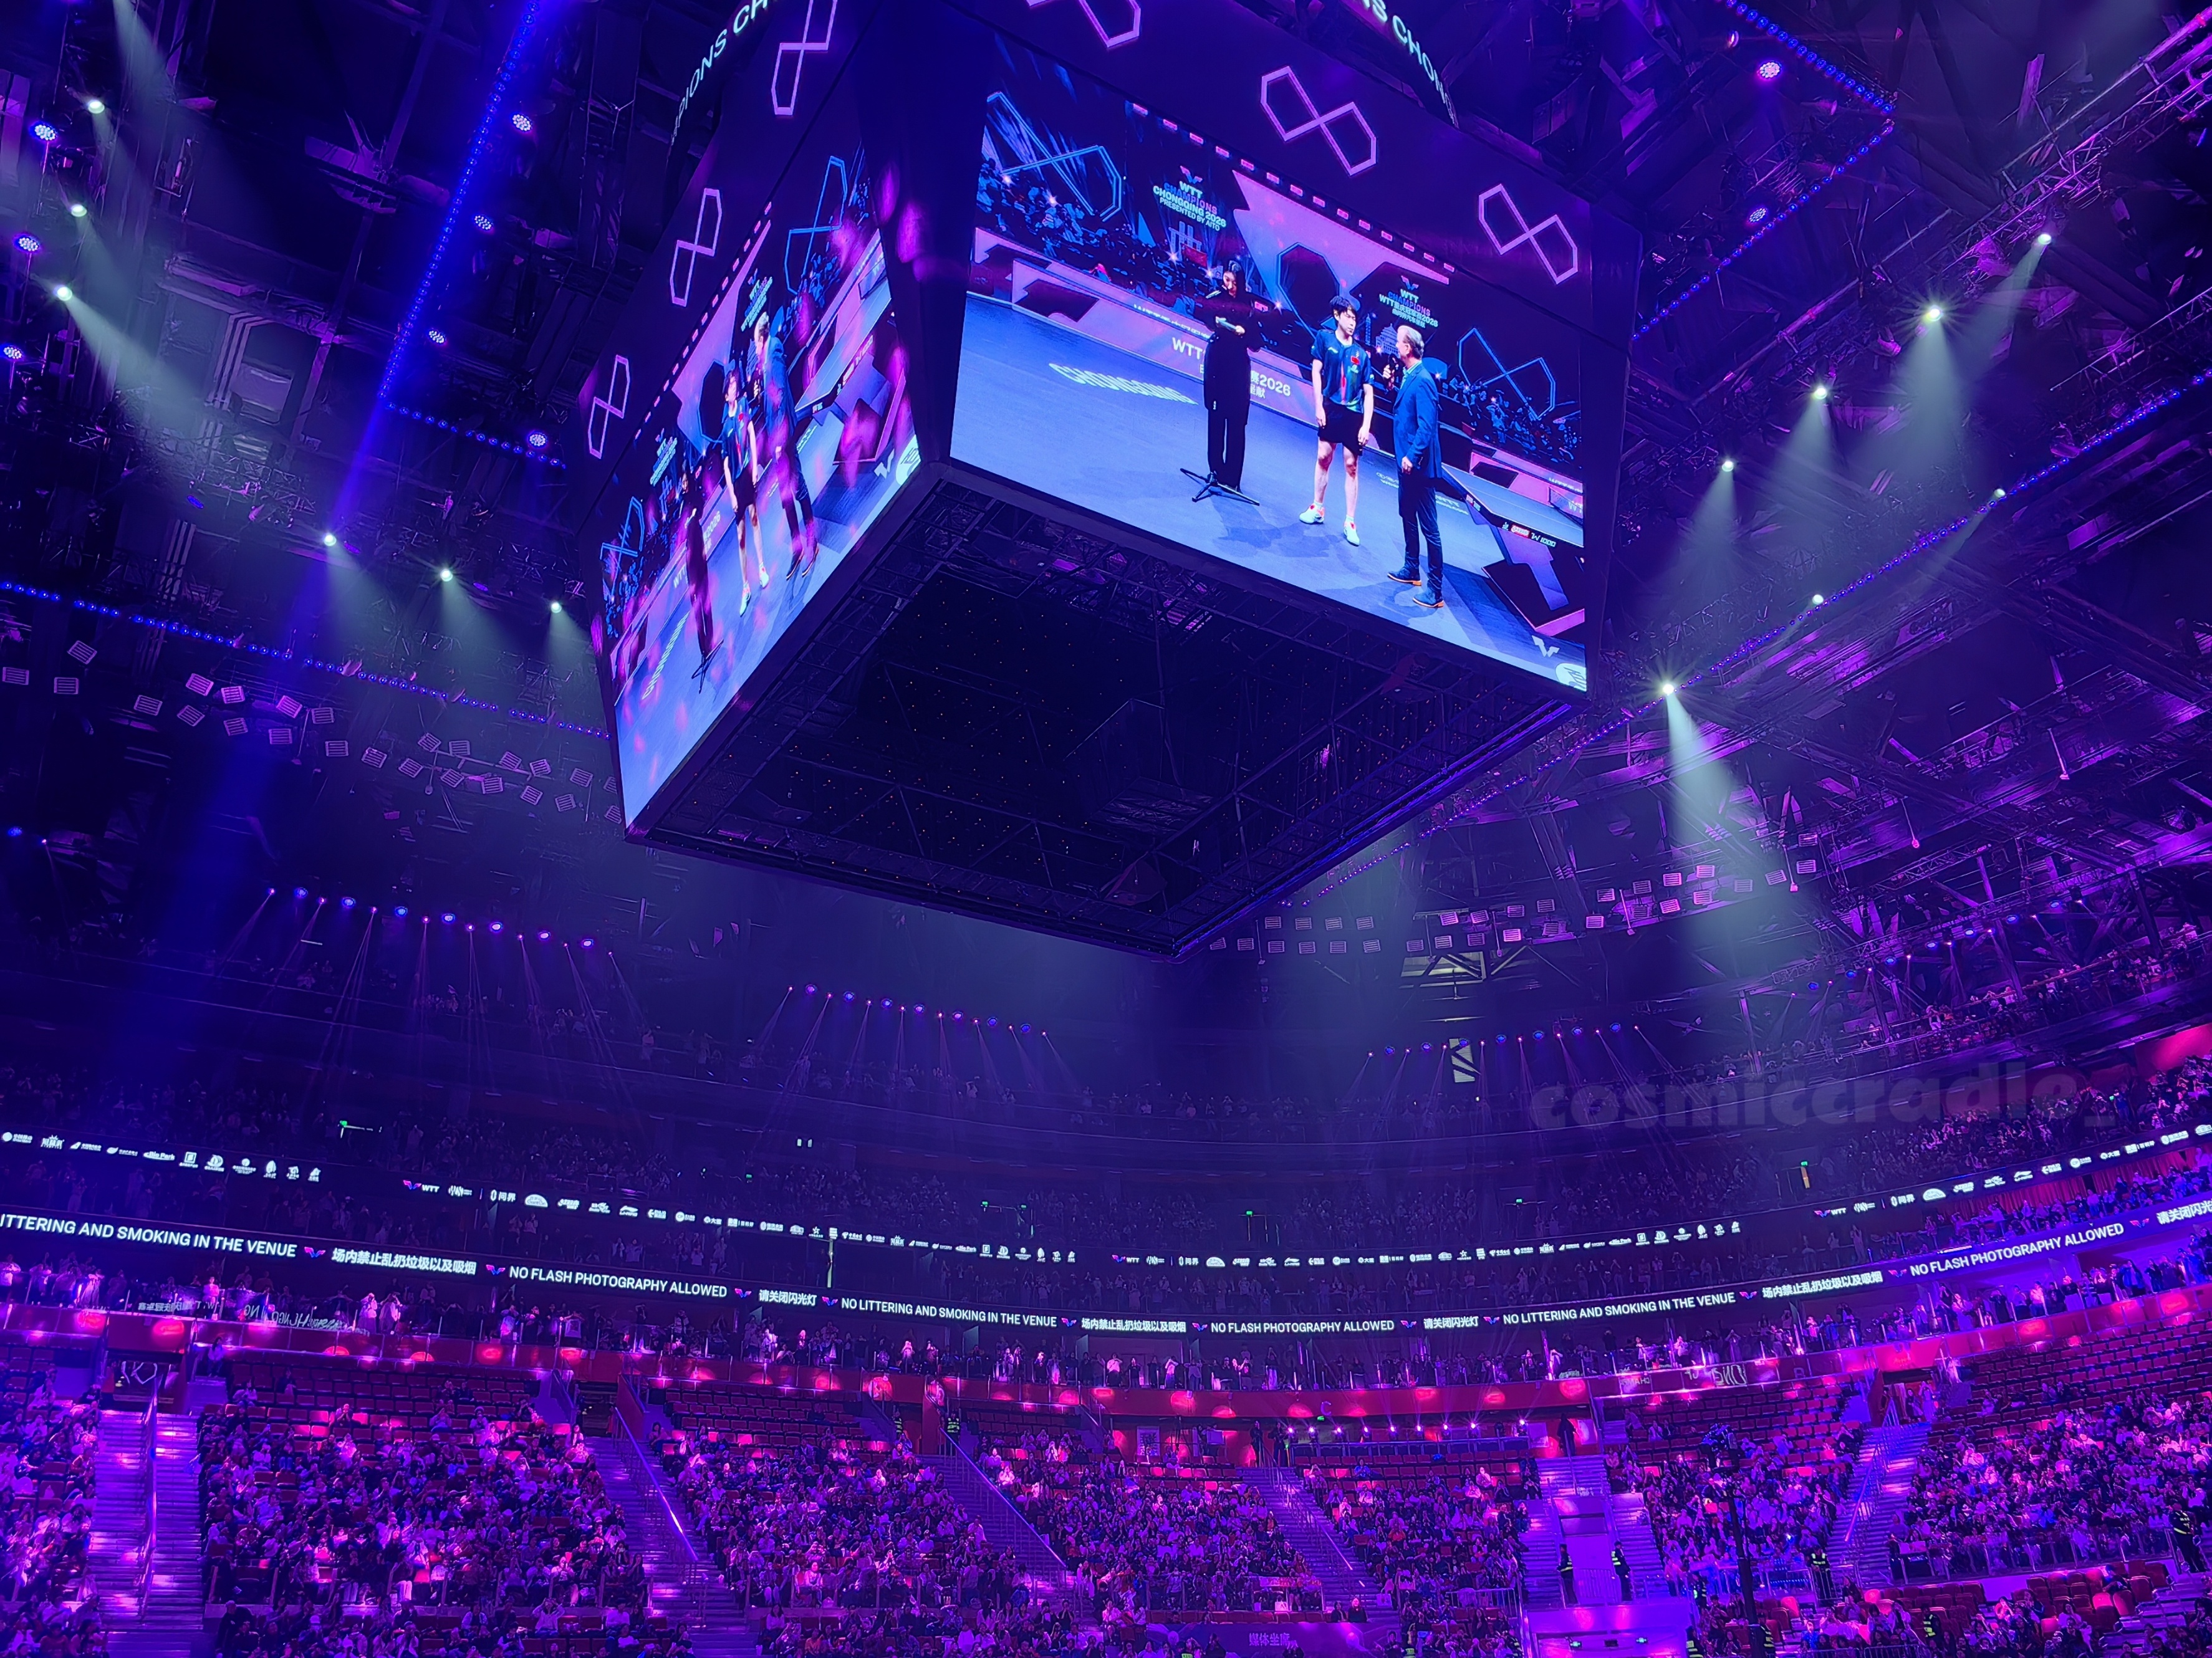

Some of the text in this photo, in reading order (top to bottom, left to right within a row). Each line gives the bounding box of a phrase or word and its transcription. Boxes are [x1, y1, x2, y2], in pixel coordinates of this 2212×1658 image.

[1164, 183, 1217, 215] CHAMPIONS
[1180, 181, 1203, 198] WTT
[1153, 186, 1226, 228] CHONGQING 2026
[1160, 197, 1220, 231] PRESENTED BY AITO
[1388, 291, 1430, 316] CHAMPIONS
[1400, 289, 1418, 304] WTT
[1172, 337, 1206, 362] WTT
[499, 1191, 516, 1202] 问界
[2156, 1198, 2212, 1225] 请关闭闪光
[0, 1214, 297, 1257] ITTERING AND SMOKING IN THE VENUE
[332, 1248, 477, 1275] 场内禁止乱扔垃圾以及吸烟
[1910, 1223, 2123, 1277] NO FLASH PHOTOGRAPHY ALLOWED
[509, 1266, 727, 1297] NO FLASH PHOTOGRAPHY ALLOWED
[1762, 1271, 1883, 1298] 场内禁止乱扔垃圾以及吸烟
[759, 1290, 817, 1306] 请关闭闪光灯
[1503, 1292, 1736, 1325] NO LITTERING AND SMOKING IN THE VENUE
[842, 1298, 1057, 1327] NO LITTERING AND SMOKING IN THE VENUE
[1082, 1317, 1186, 1333] 场内禁止乱扔垃圾以及吸烟
[1423, 1315, 1479, 1330] 请关闭闪光灯
[1211, 1320, 1394, 1333] NO FLASH PHOTOGRAPHY ALLOWED
